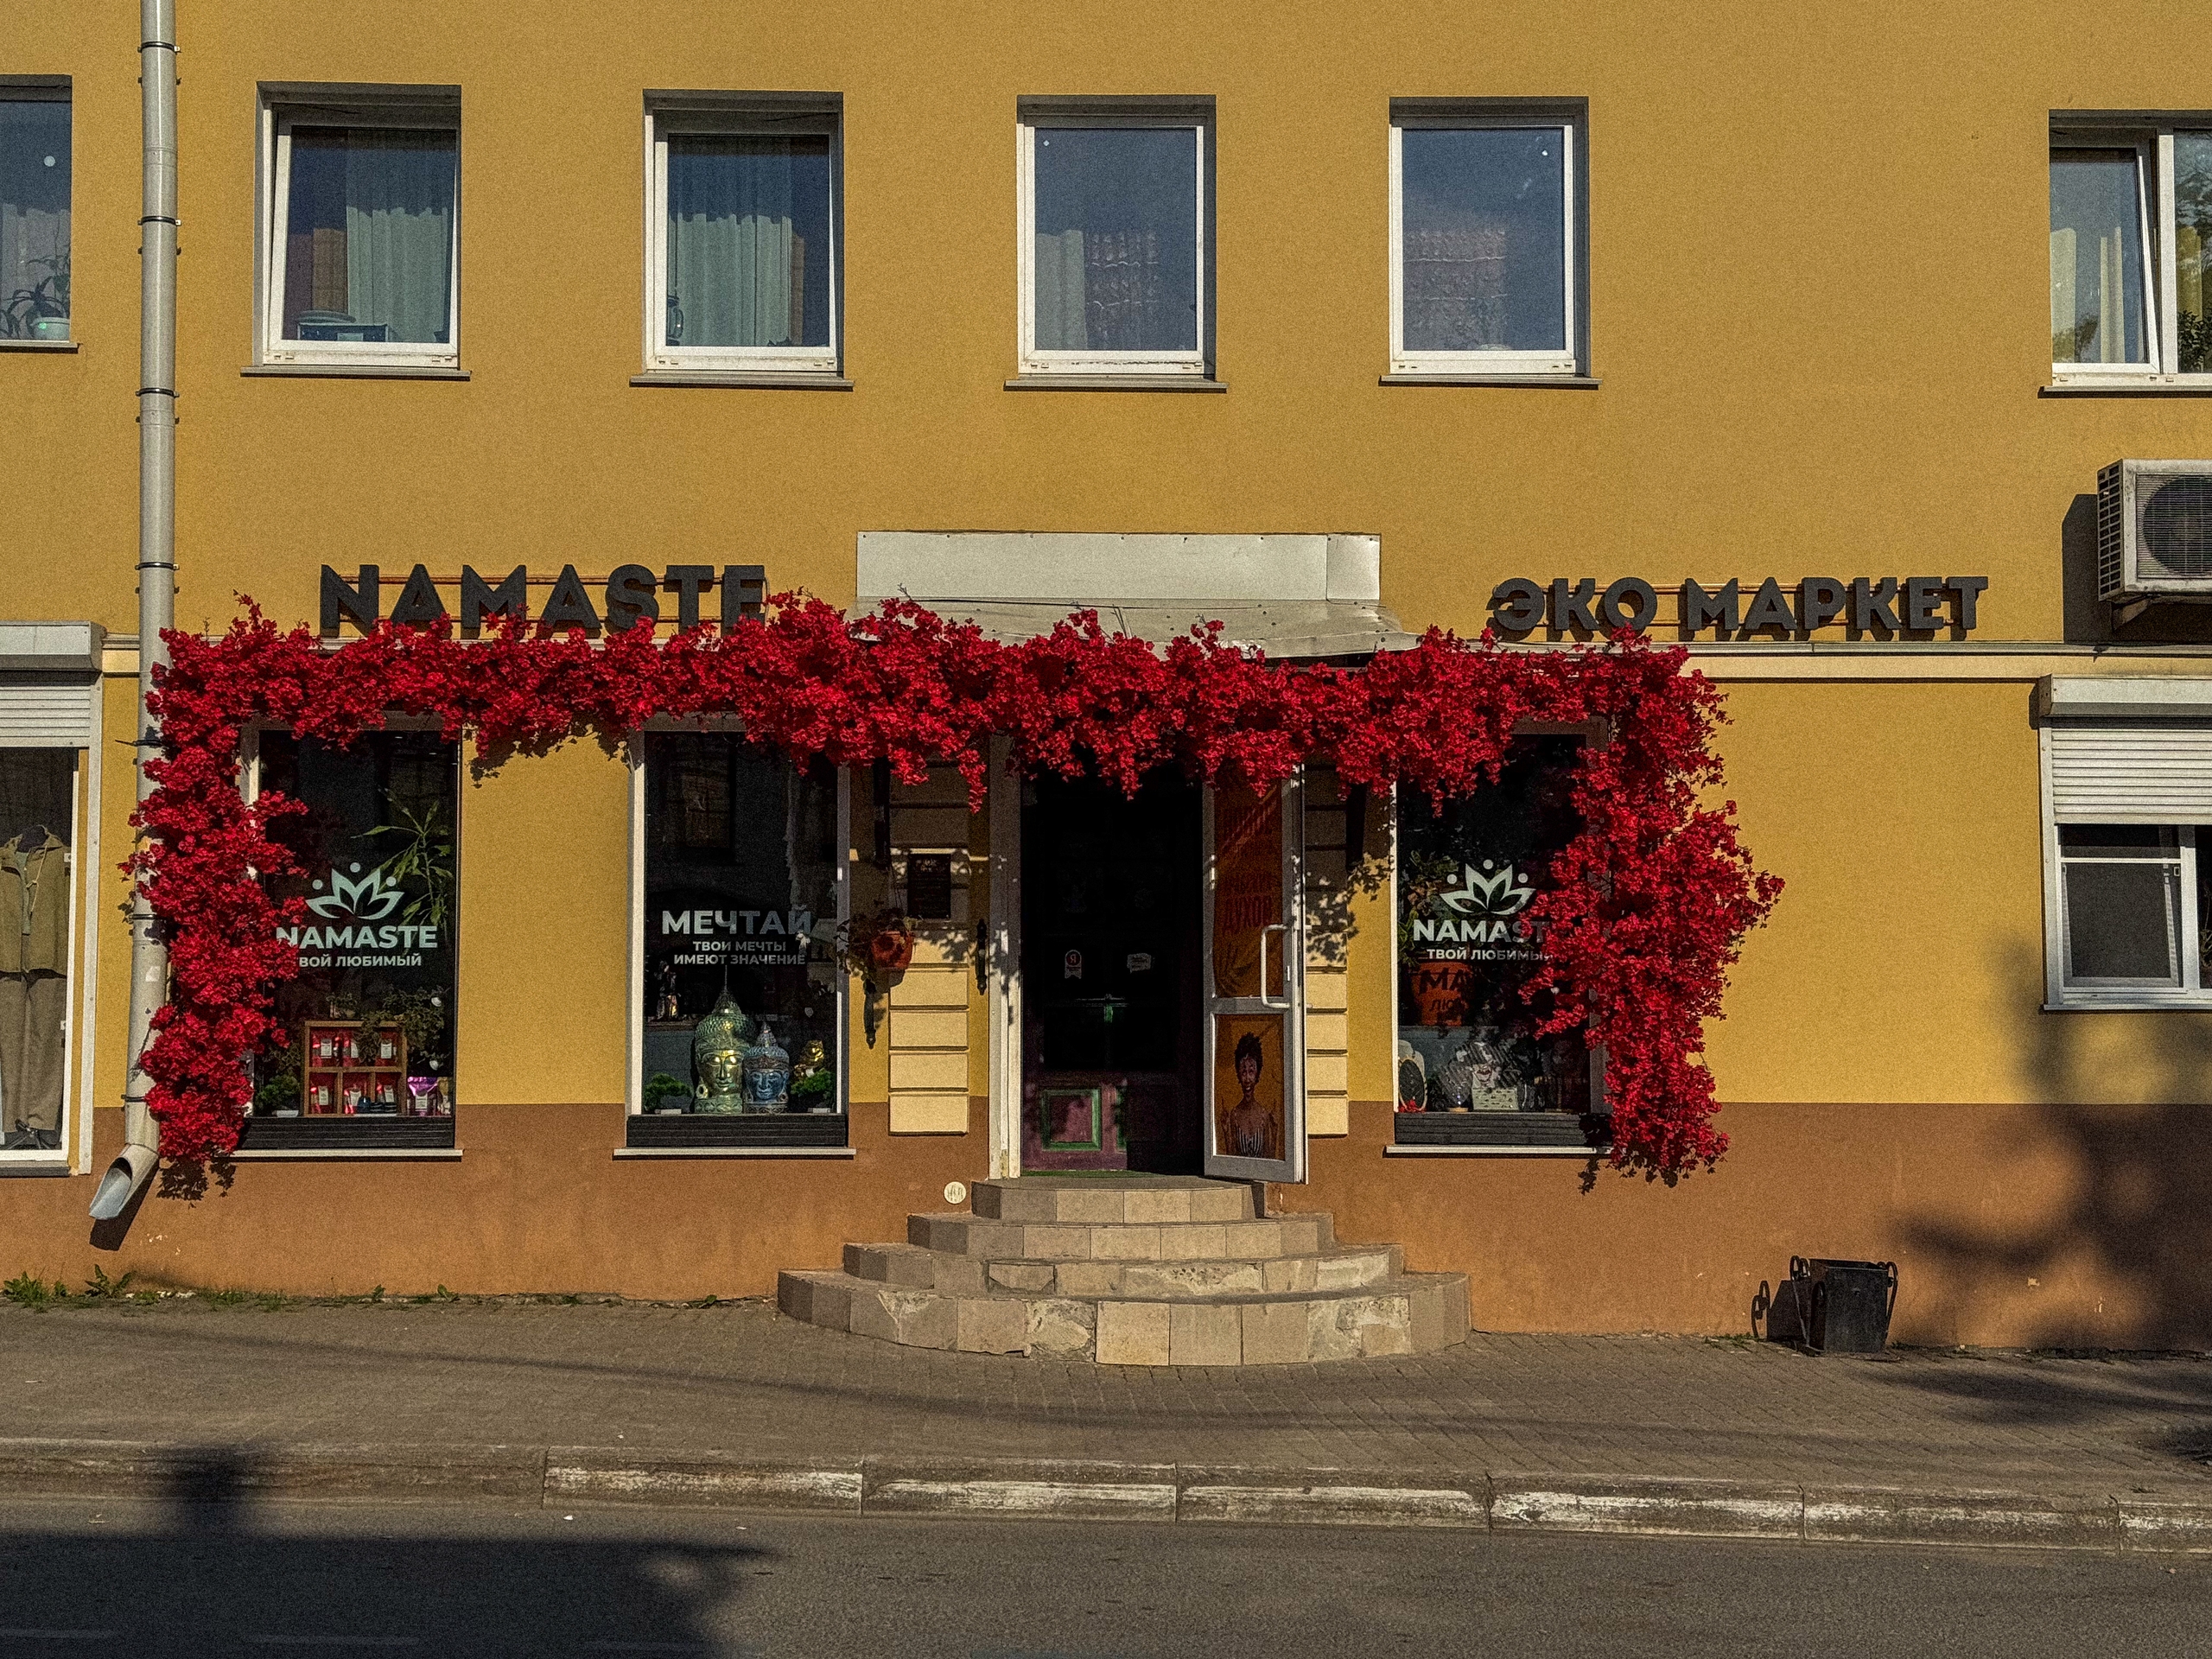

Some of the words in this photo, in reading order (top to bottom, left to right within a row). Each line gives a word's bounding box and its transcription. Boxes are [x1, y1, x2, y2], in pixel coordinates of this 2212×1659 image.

[321, 564, 766, 633] NAMASTE
[1490, 576, 1657, 632] ЭКО
[1684, 576, 1988, 632] МАРКЕТ
[662, 905, 812, 935] МЕЧТАЙ
[1413, 919, 1551, 944] NAMAST
[276, 925, 438, 949] NAMASTE
[693, 941, 732, 951] ТВОИ
[735, 941, 786, 951] МЕЧТЫ
[298, 954, 332, 967] ВОЙ
[335, 953, 422, 967] ЛЮБИМЫЙ
[674, 954, 728, 965] ИМЕЮТ
[730, 954, 806, 965] ЗНАЧЕНИЕ
[1427, 947, 1467, 960] ТВОЙ
